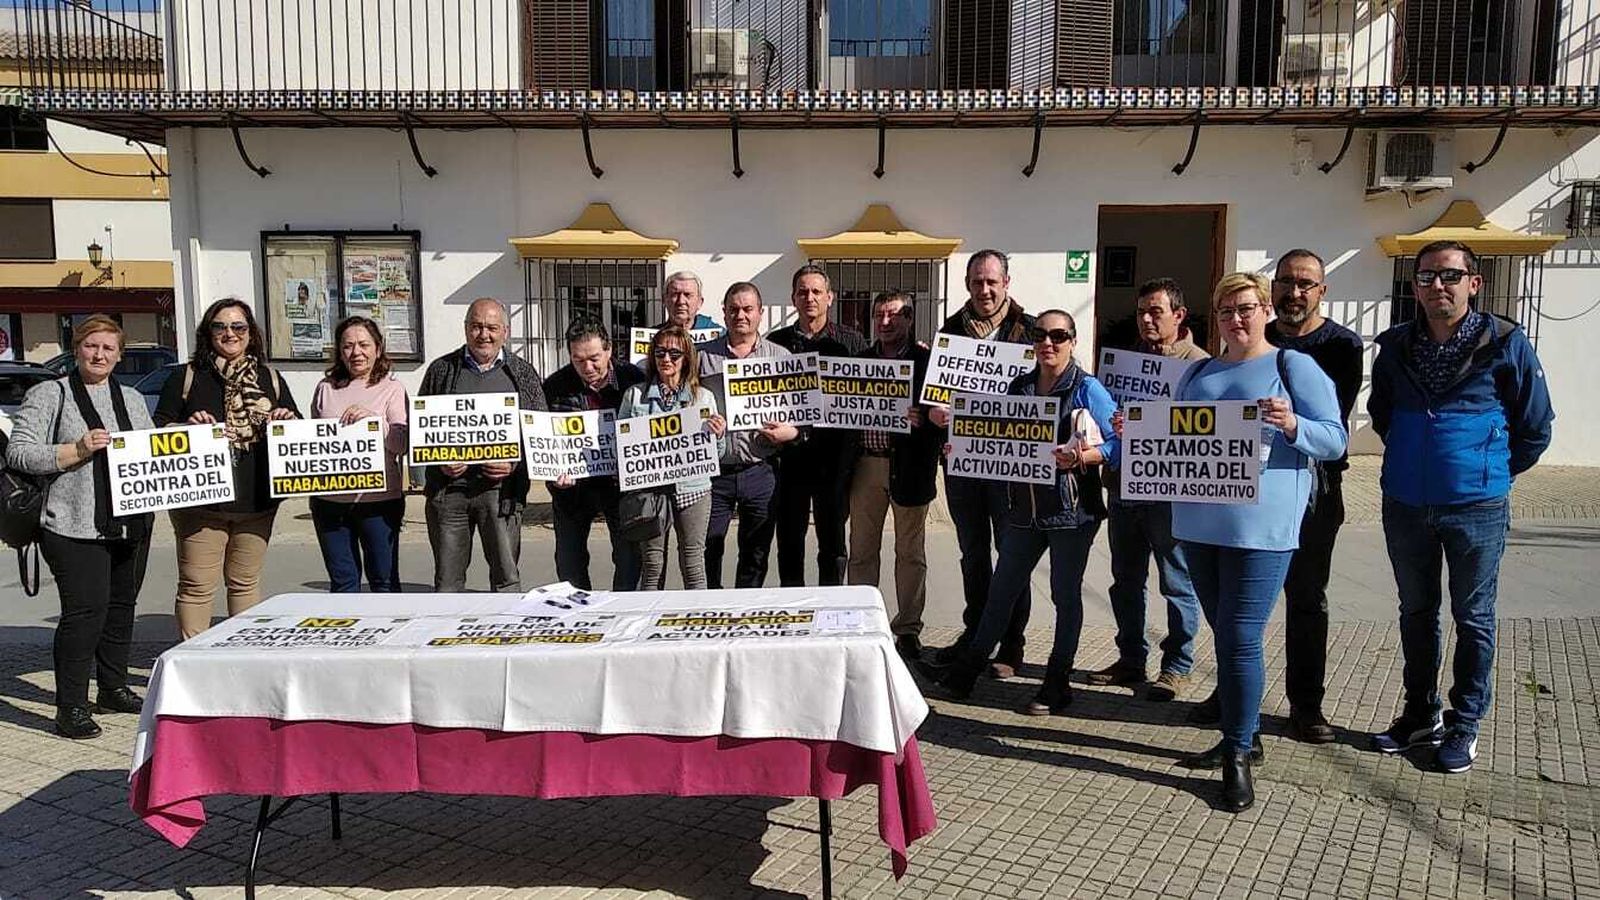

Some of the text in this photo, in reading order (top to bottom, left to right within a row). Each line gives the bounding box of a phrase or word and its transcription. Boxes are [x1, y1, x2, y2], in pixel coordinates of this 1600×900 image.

[976, 343, 996, 357] EN
[742, 359, 804, 376] POR UNA
[832, 363, 896, 378] POR UNA
[937, 355, 1028, 377] DEFENSA DE
[1141, 359, 1162, 375] EN
[730, 373, 818, 395] REGULACIÓN
[821, 380, 909, 396] REGULACIÓN
[938, 372, 1008, 393] NUESTRO
[1104, 373, 1171, 397] DEFENSA
[456, 399, 475, 411] EN
[744, 392, 808, 409] JUSTA DE
[830, 397, 896, 411] JUSTA DE
[970, 400, 1039, 418] POR UNA
[419, 413, 512, 428] DEFENSA DE
[733, 408, 821, 426] ACTIVIDADES
[1172, 408, 1214, 434] NO
[316, 423, 337, 437] EN
[552, 416, 585, 436] NO
[650, 415, 681, 438] NO
[954, 420, 1053, 440] REGULACIÓN
[151, 432, 189, 456] NO
[425, 430, 507, 444] NUESTROS
[529, 433, 615, 450] ESTAMOS EN
[623, 431, 711, 458] ESTAMOS EN
[278, 439, 377, 456] DEFENSA DE
[414, 445, 518, 462] TRABAJADORES
[966, 439, 1038, 458] JUSTA DE
[1130, 439, 1253, 457] ESTAMOS EN
[532, 448, 616, 465] CONTRA DEL
[626, 448, 712, 473] CONTRA DEL
[117, 453, 225, 478] ESTAMOS EN
[285, 457, 372, 474] NUESTROS
[567, 463, 618, 475] ASOCIATIV
[952, 457, 1052, 479] ACTIVIDADES
[1131, 460, 1251, 480] CONTRA DEL
[625, 463, 716, 486] SECTOR ASOCIATIVO
[121, 471, 226, 496] CONTRA DEL
[274, 474, 383, 493] TRABAJADORES
[1128, 482, 1255, 499] SECTOR ASOCIATIVO
[120, 487, 230, 511] SECTOR ASOCIATIVO
[300, 618, 356, 627] NO
[457, 622, 565, 630] DEFENSA
[226, 634, 326, 642] CONTRA
[434, 635, 602, 645] TRABAJADORES
[457, 628, 590, 637] NUESTROS
[647, 630, 810, 639] ACTIVIDADES
